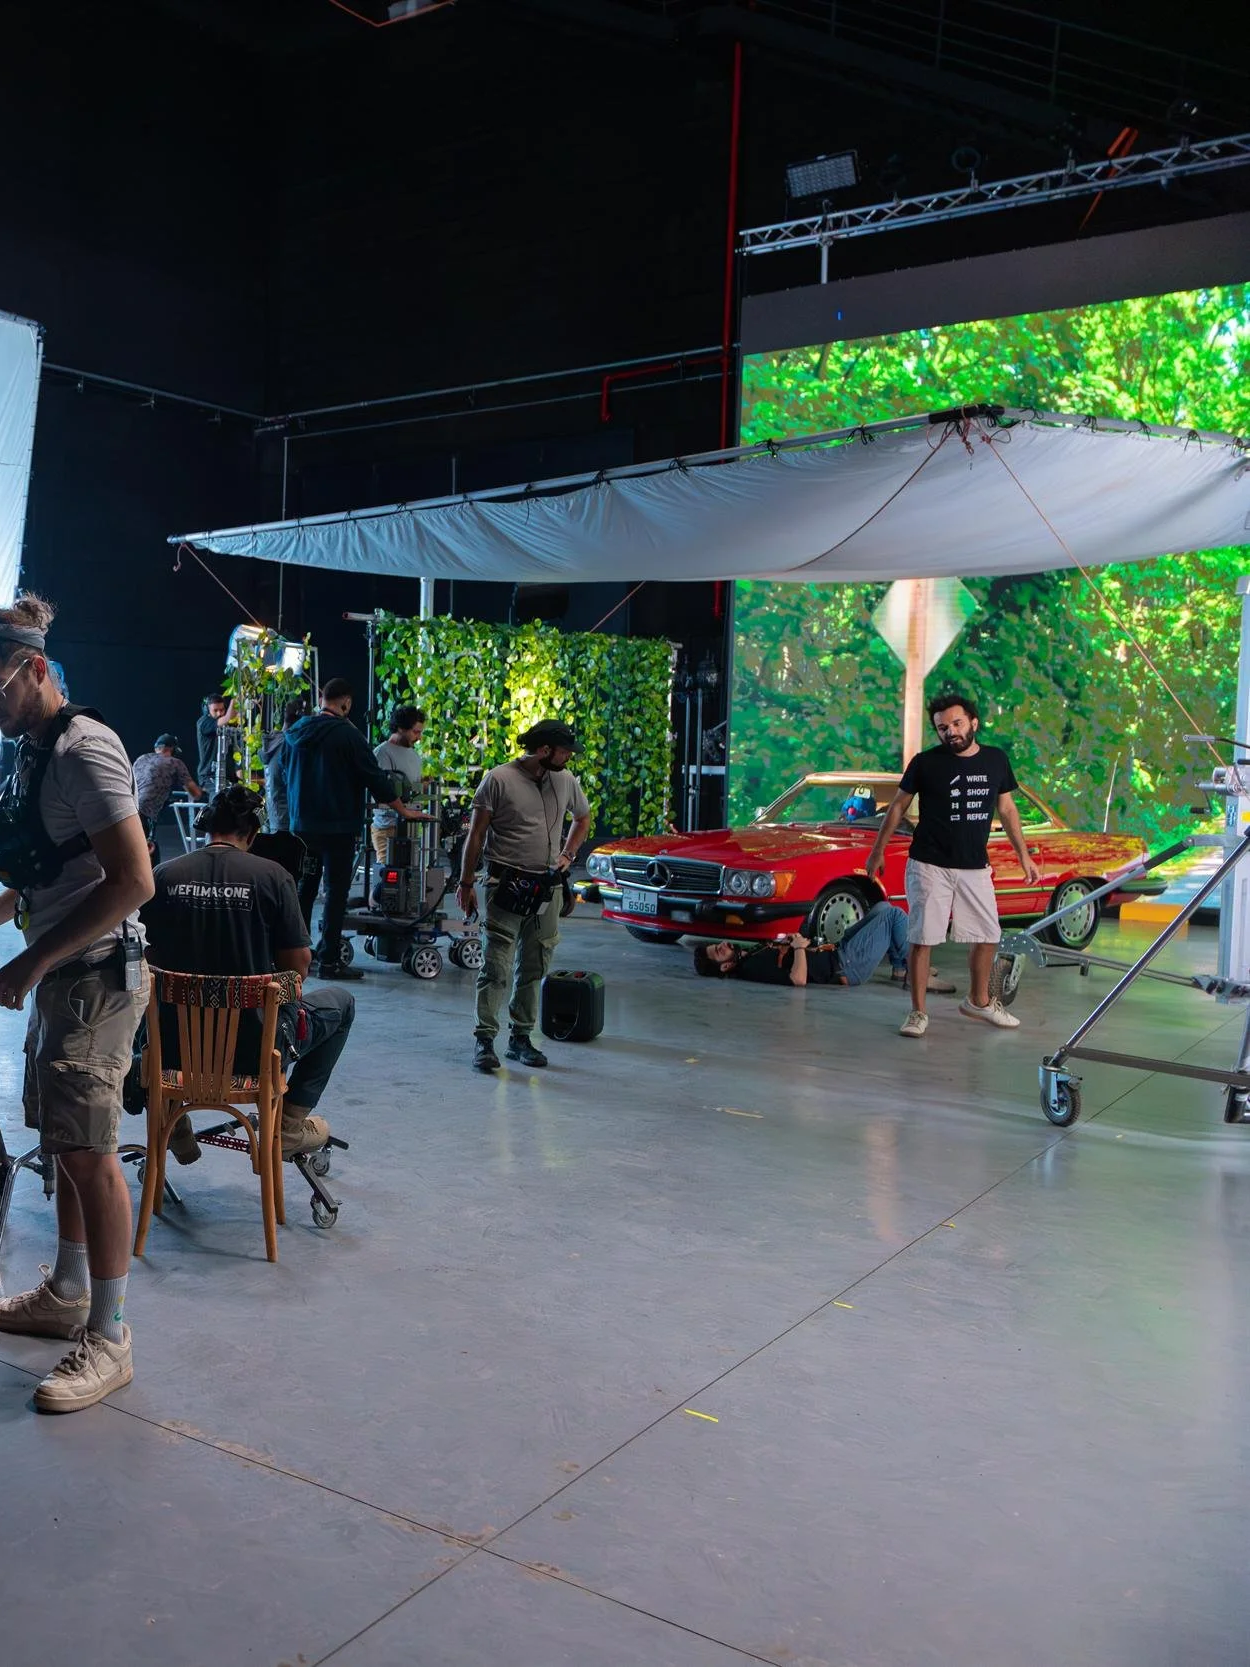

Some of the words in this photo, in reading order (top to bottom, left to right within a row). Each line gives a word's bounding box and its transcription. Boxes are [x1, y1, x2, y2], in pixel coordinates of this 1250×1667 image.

[966, 775, 988, 783] WRITE
[966, 788, 990, 796] SHOOT
[966, 801, 983, 809] EDIT
[966, 812, 989, 821] REPEAT
